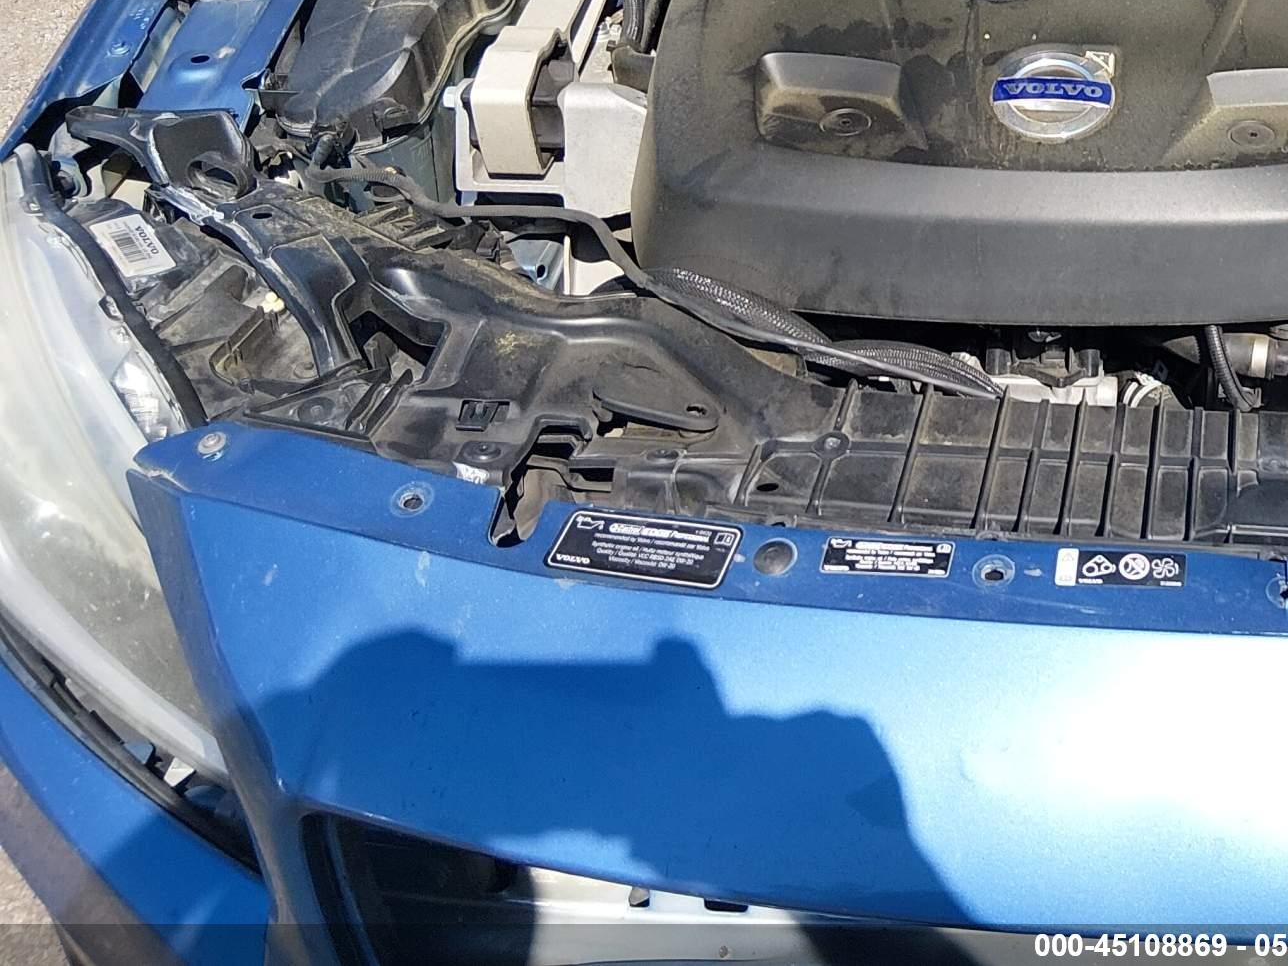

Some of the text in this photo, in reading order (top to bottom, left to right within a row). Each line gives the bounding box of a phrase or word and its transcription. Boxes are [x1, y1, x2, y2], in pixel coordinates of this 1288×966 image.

[1003, 82, 1103, 98] VOLVO
[135, 225, 160, 255] VOLVO
[556, 553, 591, 565] VOLVO
